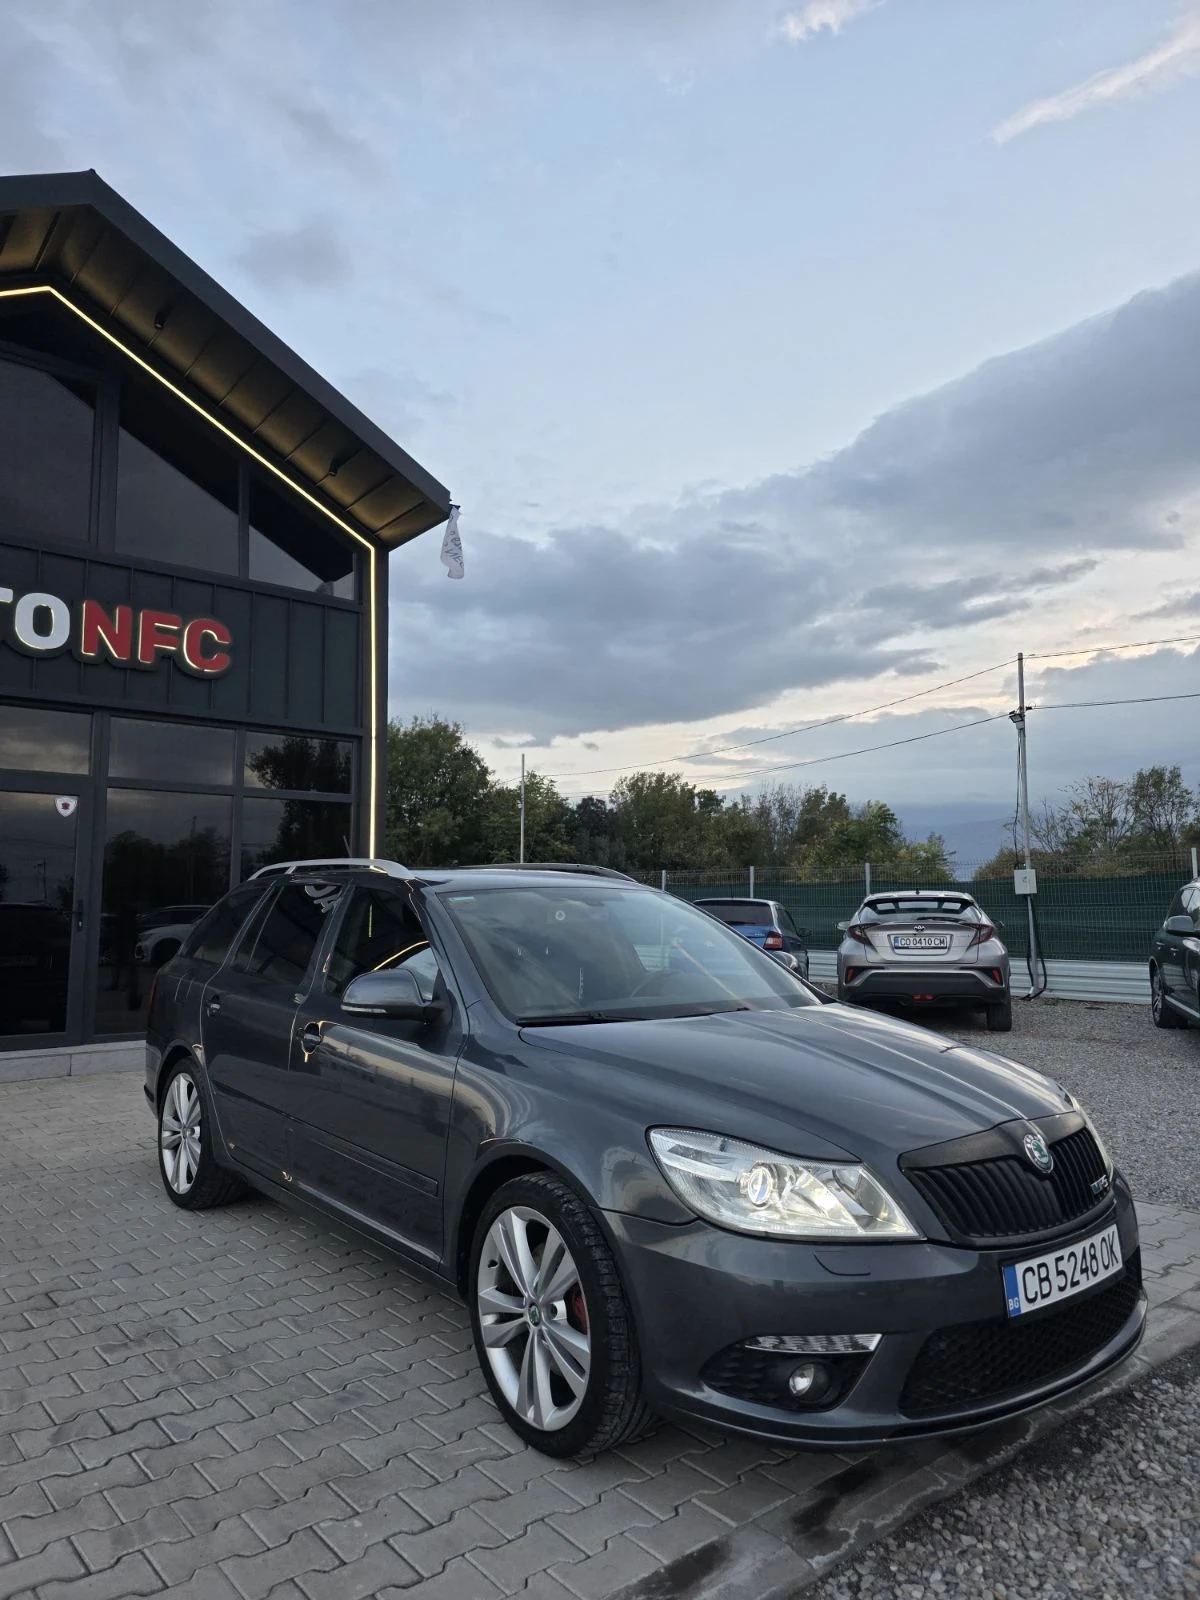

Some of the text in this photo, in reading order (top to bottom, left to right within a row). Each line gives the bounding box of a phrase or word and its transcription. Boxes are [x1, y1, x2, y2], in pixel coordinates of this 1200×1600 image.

[1021, 1231, 1119, 1304] CB 5248 OK
[1008, 1297, 1020, 1311] BG
